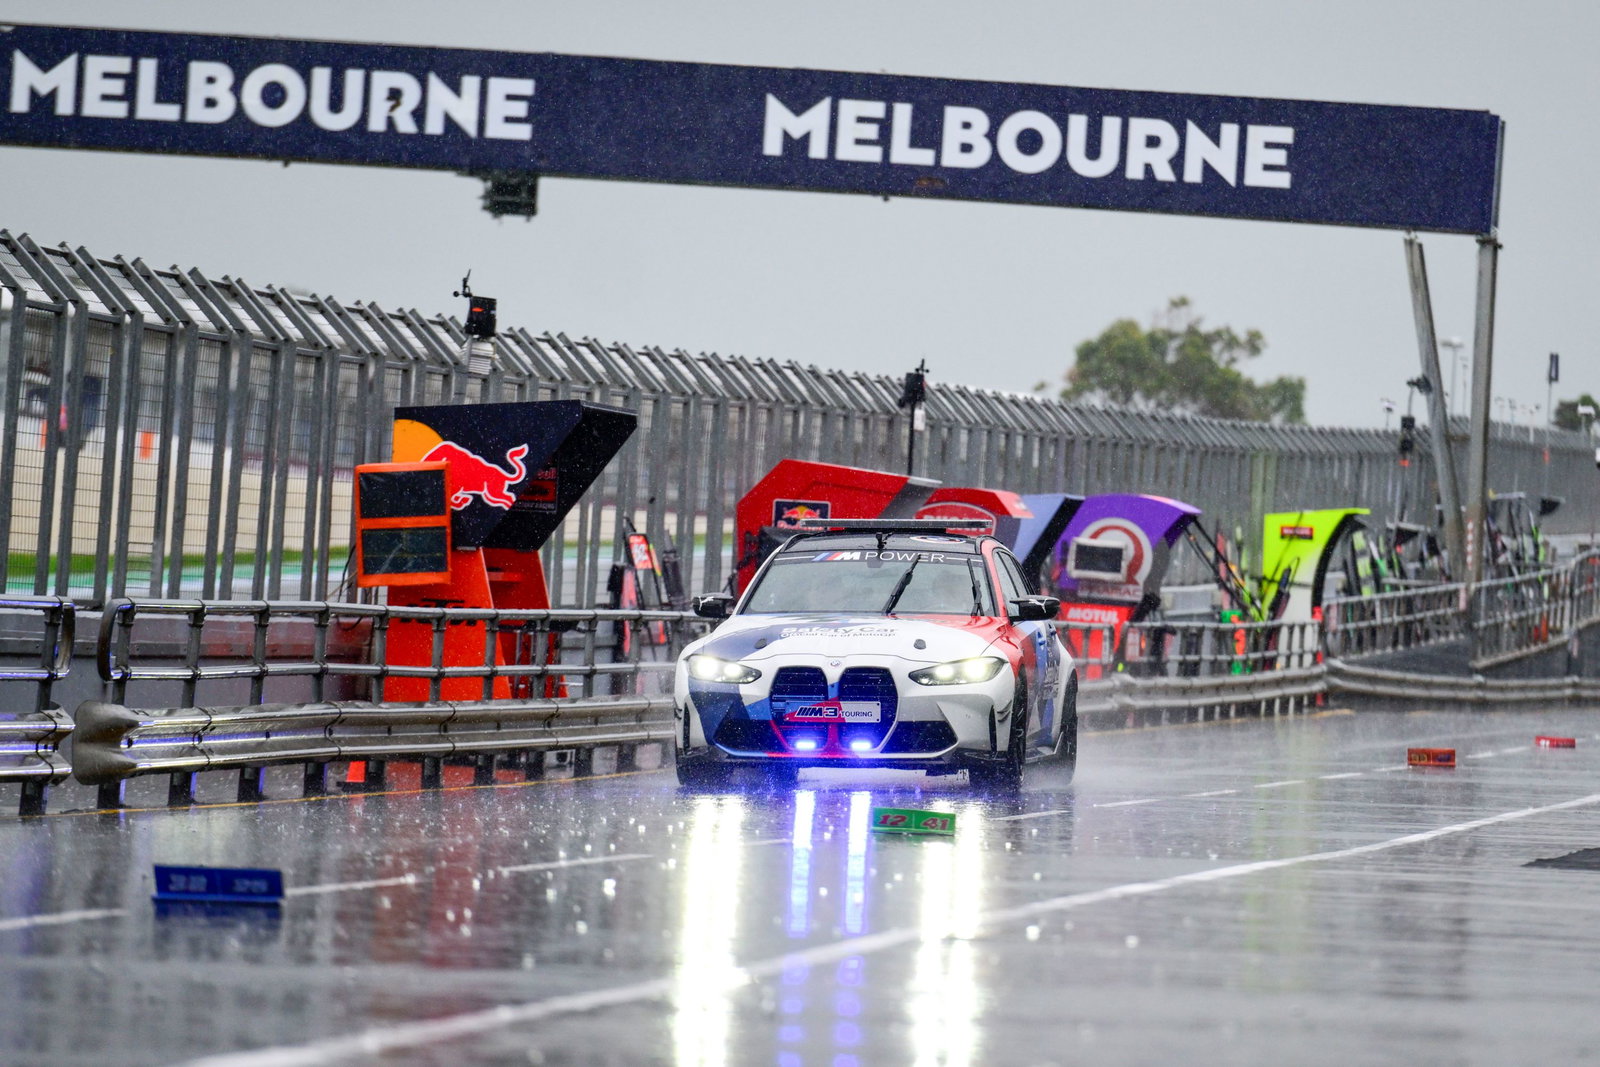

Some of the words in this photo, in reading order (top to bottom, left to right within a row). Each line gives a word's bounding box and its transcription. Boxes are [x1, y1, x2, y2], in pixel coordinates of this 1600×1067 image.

[10, 49, 536, 140] MELBOURNE
[762, 93, 1294, 189] MELBOURNE
[865, 551, 945, 563] POWER
[1067, 607, 1120, 624] MOTUL
[782, 626, 854, 634] Safety
[878, 814, 907, 826] 12
[922, 817, 949, 830] 41
